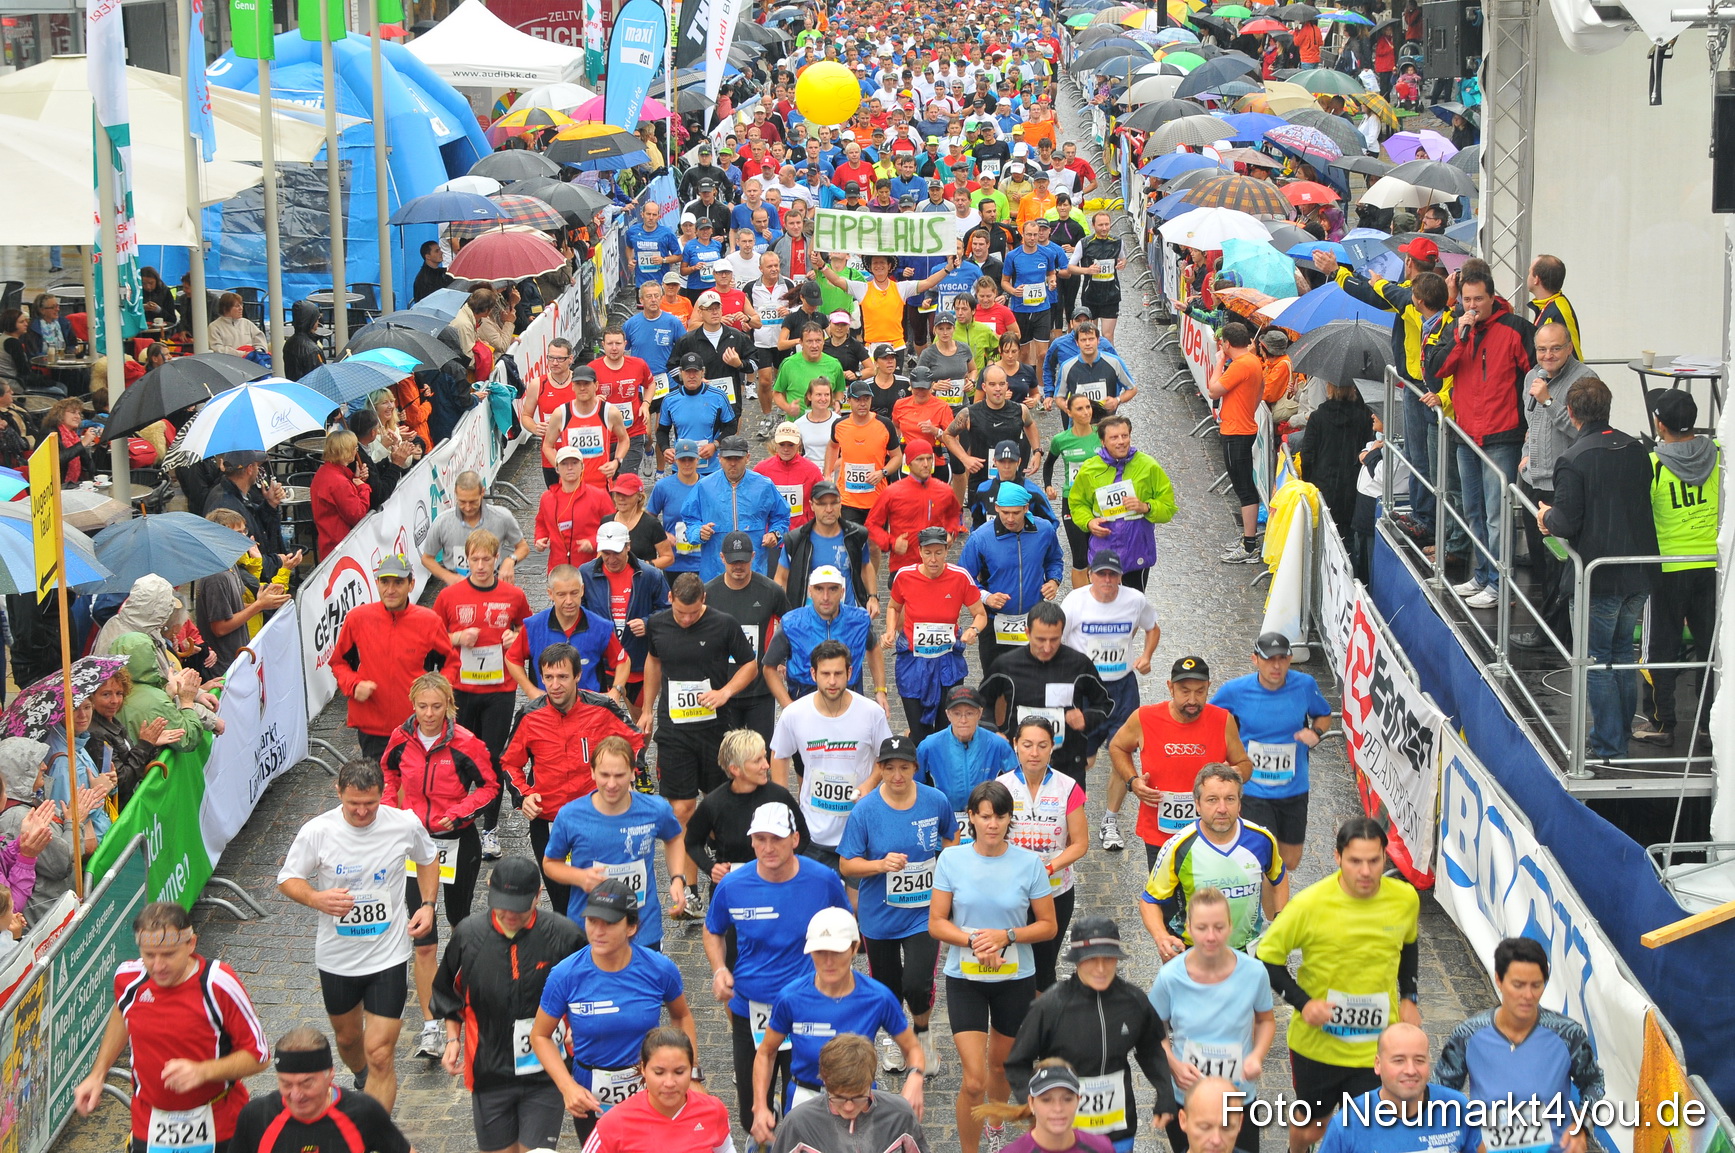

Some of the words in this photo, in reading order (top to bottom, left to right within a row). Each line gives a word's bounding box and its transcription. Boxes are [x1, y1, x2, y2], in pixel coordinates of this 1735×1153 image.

[625, 26, 653, 44] maxi
[715, 18, 727, 60] Audi
[639, 52, 649, 65] dsl
[452, 69, 538, 80] www.audibkk.de
[983, 163, 998, 171] 2291
[816, 213, 946, 254] APPLAUS
[1028, 290, 1042, 298] 475
[572, 436, 600, 448] 2835
[32, 482, 53, 518] Jugend
[40, 511, 52, 539] lauf
[1089, 623, 1131, 633] STAEDTLER
[918, 632, 952, 646] 2455
[1091, 647, 1125, 662] 2407
[477, 657, 485, 670] 7
[682, 709, 702, 717] Tobias
[1252, 753, 1290, 768] 3216
[814, 781, 853, 800] 3096
[817, 800, 848, 810] Sebastian
[892, 871, 934, 893] 2540
[1203, 876, 1239, 888] TEAM
[898, 893, 928, 903] Manuela
[70, 899, 115, 968] Event-Leit-Systeme
[350, 926, 376, 936] Hubert
[54, 1001, 77, 1046] Mehr
[77, 943, 116, 1008] Sicherheit
[1330, 1005, 1382, 1027] 3386
[53, 1053, 66, 1082] für
[68, 1036, 78, 1060] Ihr
[81, 988, 106, 1039] Event!
[53, 1101, 66, 1122] Miet
[1089, 1116, 1105, 1125] Eva
[155, 1121, 208, 1145] 2524
